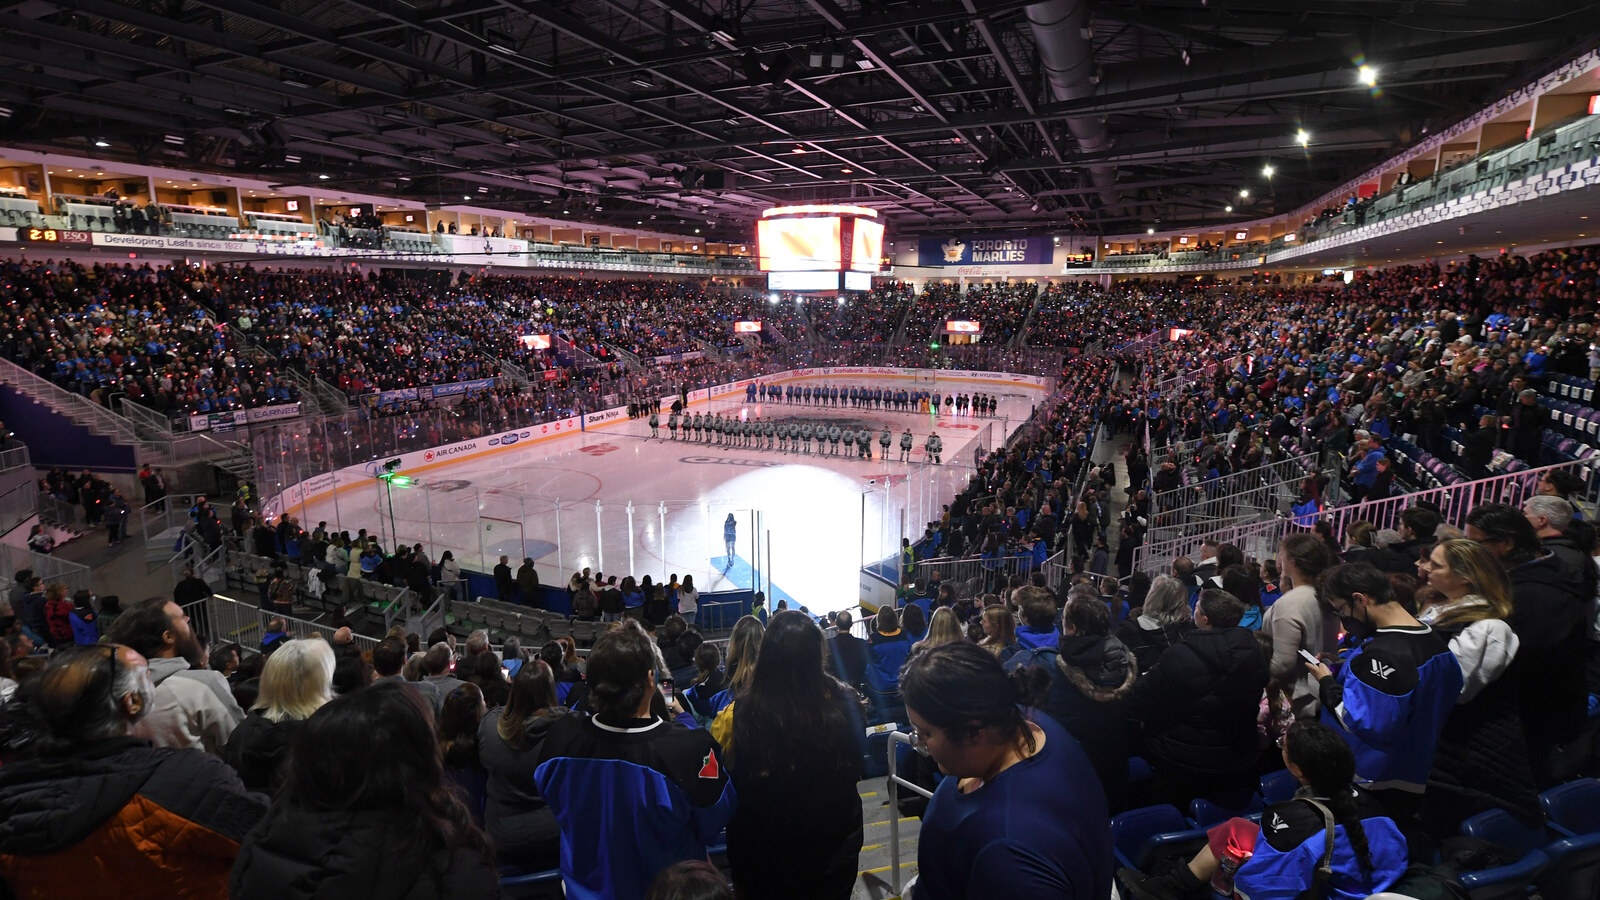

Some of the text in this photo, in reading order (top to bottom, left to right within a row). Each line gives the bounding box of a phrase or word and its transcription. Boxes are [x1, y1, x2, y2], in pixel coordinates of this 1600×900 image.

[104, 234, 243, 250] Developing Leafs since 1927
[971, 239, 1028, 251] TORONTO
[972, 251, 1025, 262] MARLIES
[254, 406, 299, 418] EARNED
[589, 413, 604, 423] Shark
[435, 443, 477, 457] AIR CANADA
